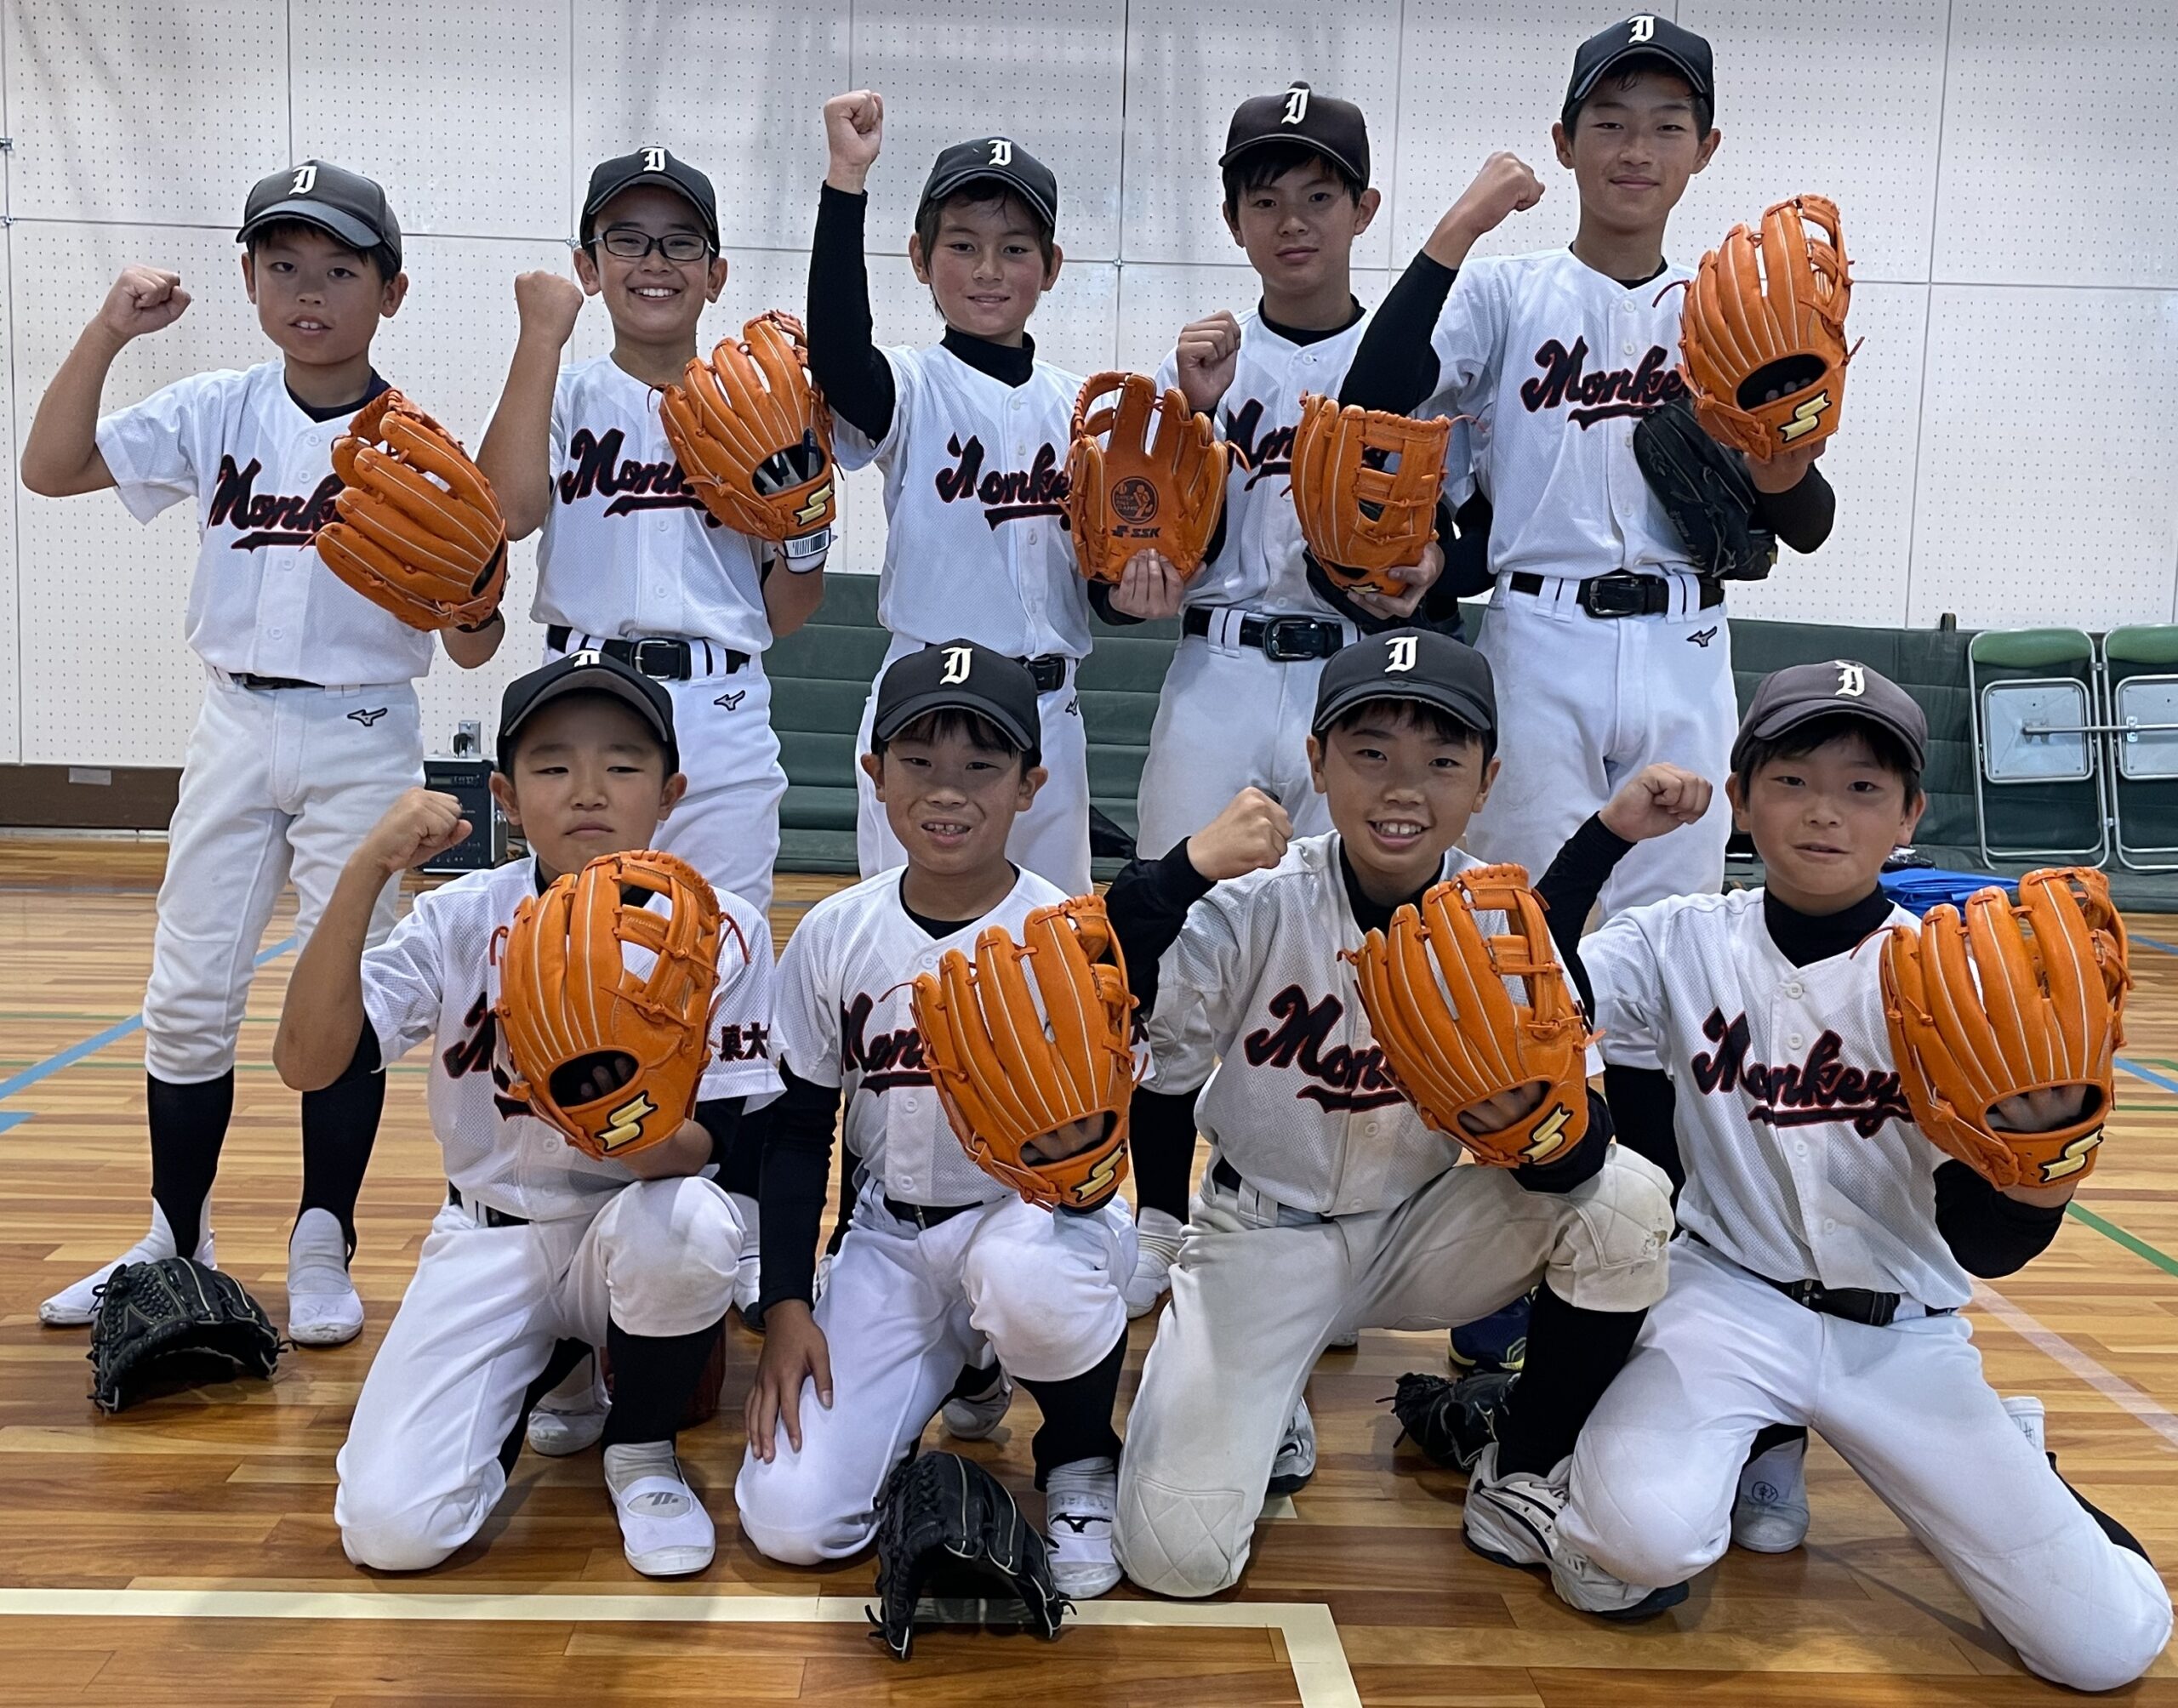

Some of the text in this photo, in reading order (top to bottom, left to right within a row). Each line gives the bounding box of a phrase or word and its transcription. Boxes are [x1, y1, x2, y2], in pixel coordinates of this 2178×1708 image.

[1520, 335, 1691, 413] Monke
[207, 454, 346, 533] Monk
[935, 431, 1071, 505] Monke
[1130, 527, 1160, 538] SSK
[1244, 983, 1400, 1091] Mon
[1691, 1006, 1915, 1138] Monkey
